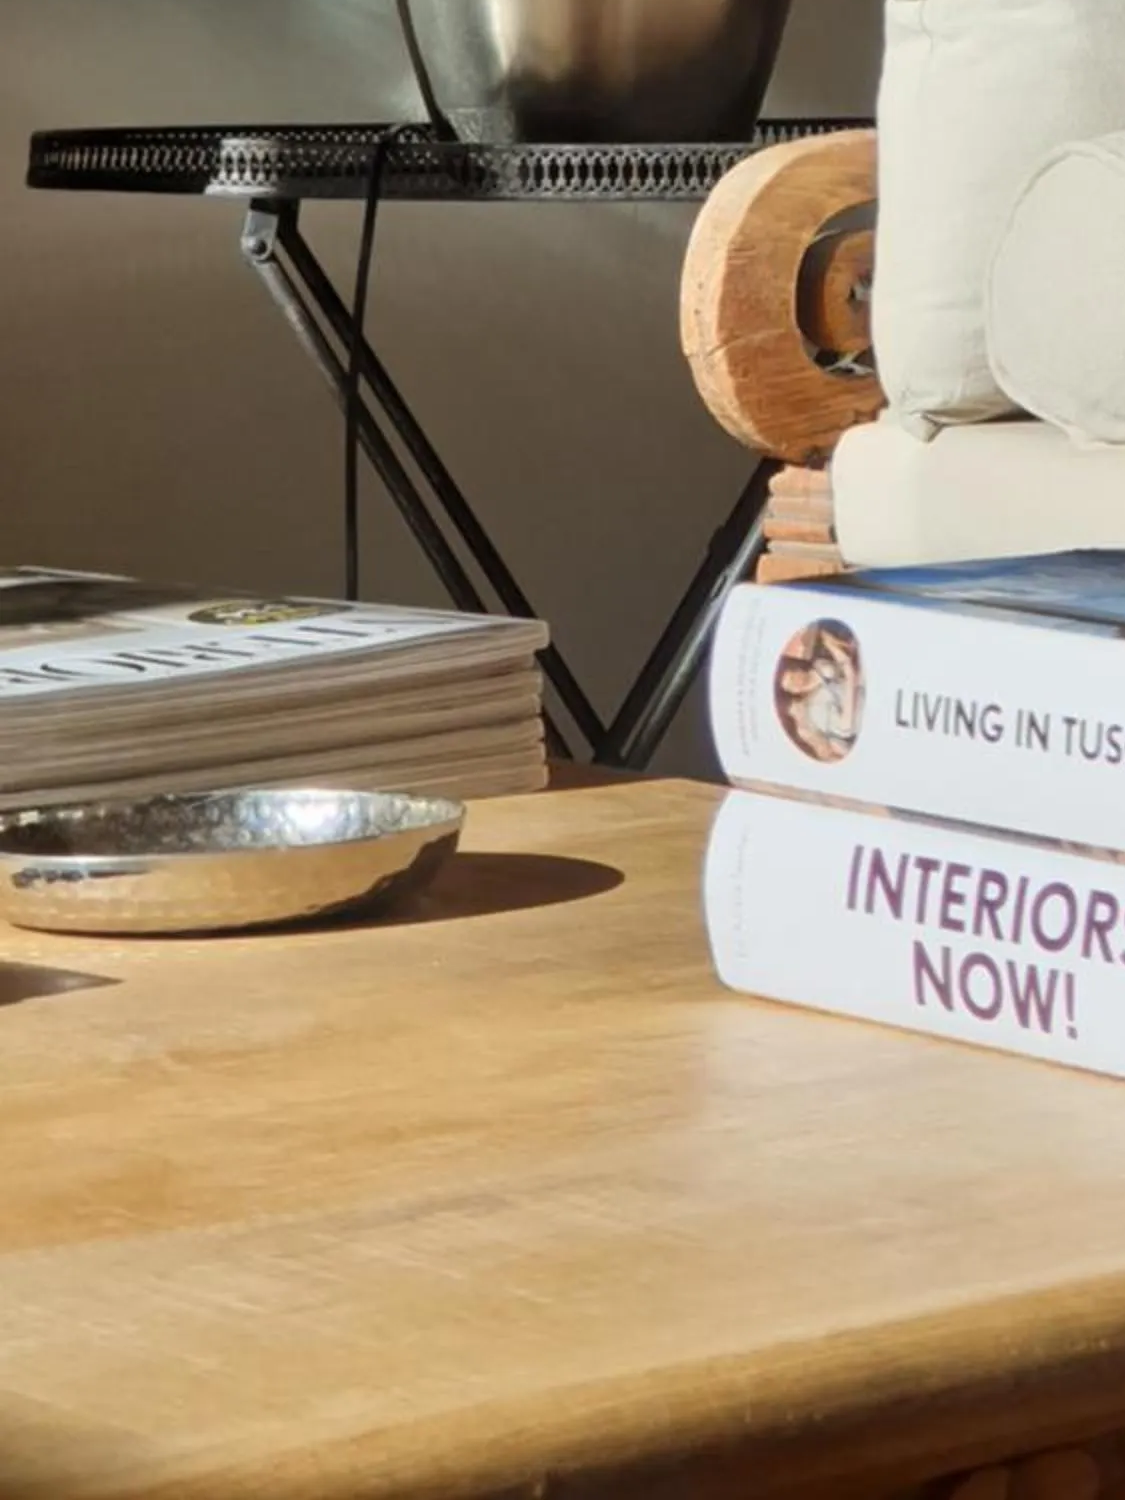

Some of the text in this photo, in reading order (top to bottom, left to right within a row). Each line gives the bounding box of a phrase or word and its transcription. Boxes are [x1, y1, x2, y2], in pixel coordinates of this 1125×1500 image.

[895, 688, 1004, 744] LIVING
[1014, 708, 1051, 753] IN
[913, 940, 1078, 1040] NOW!
